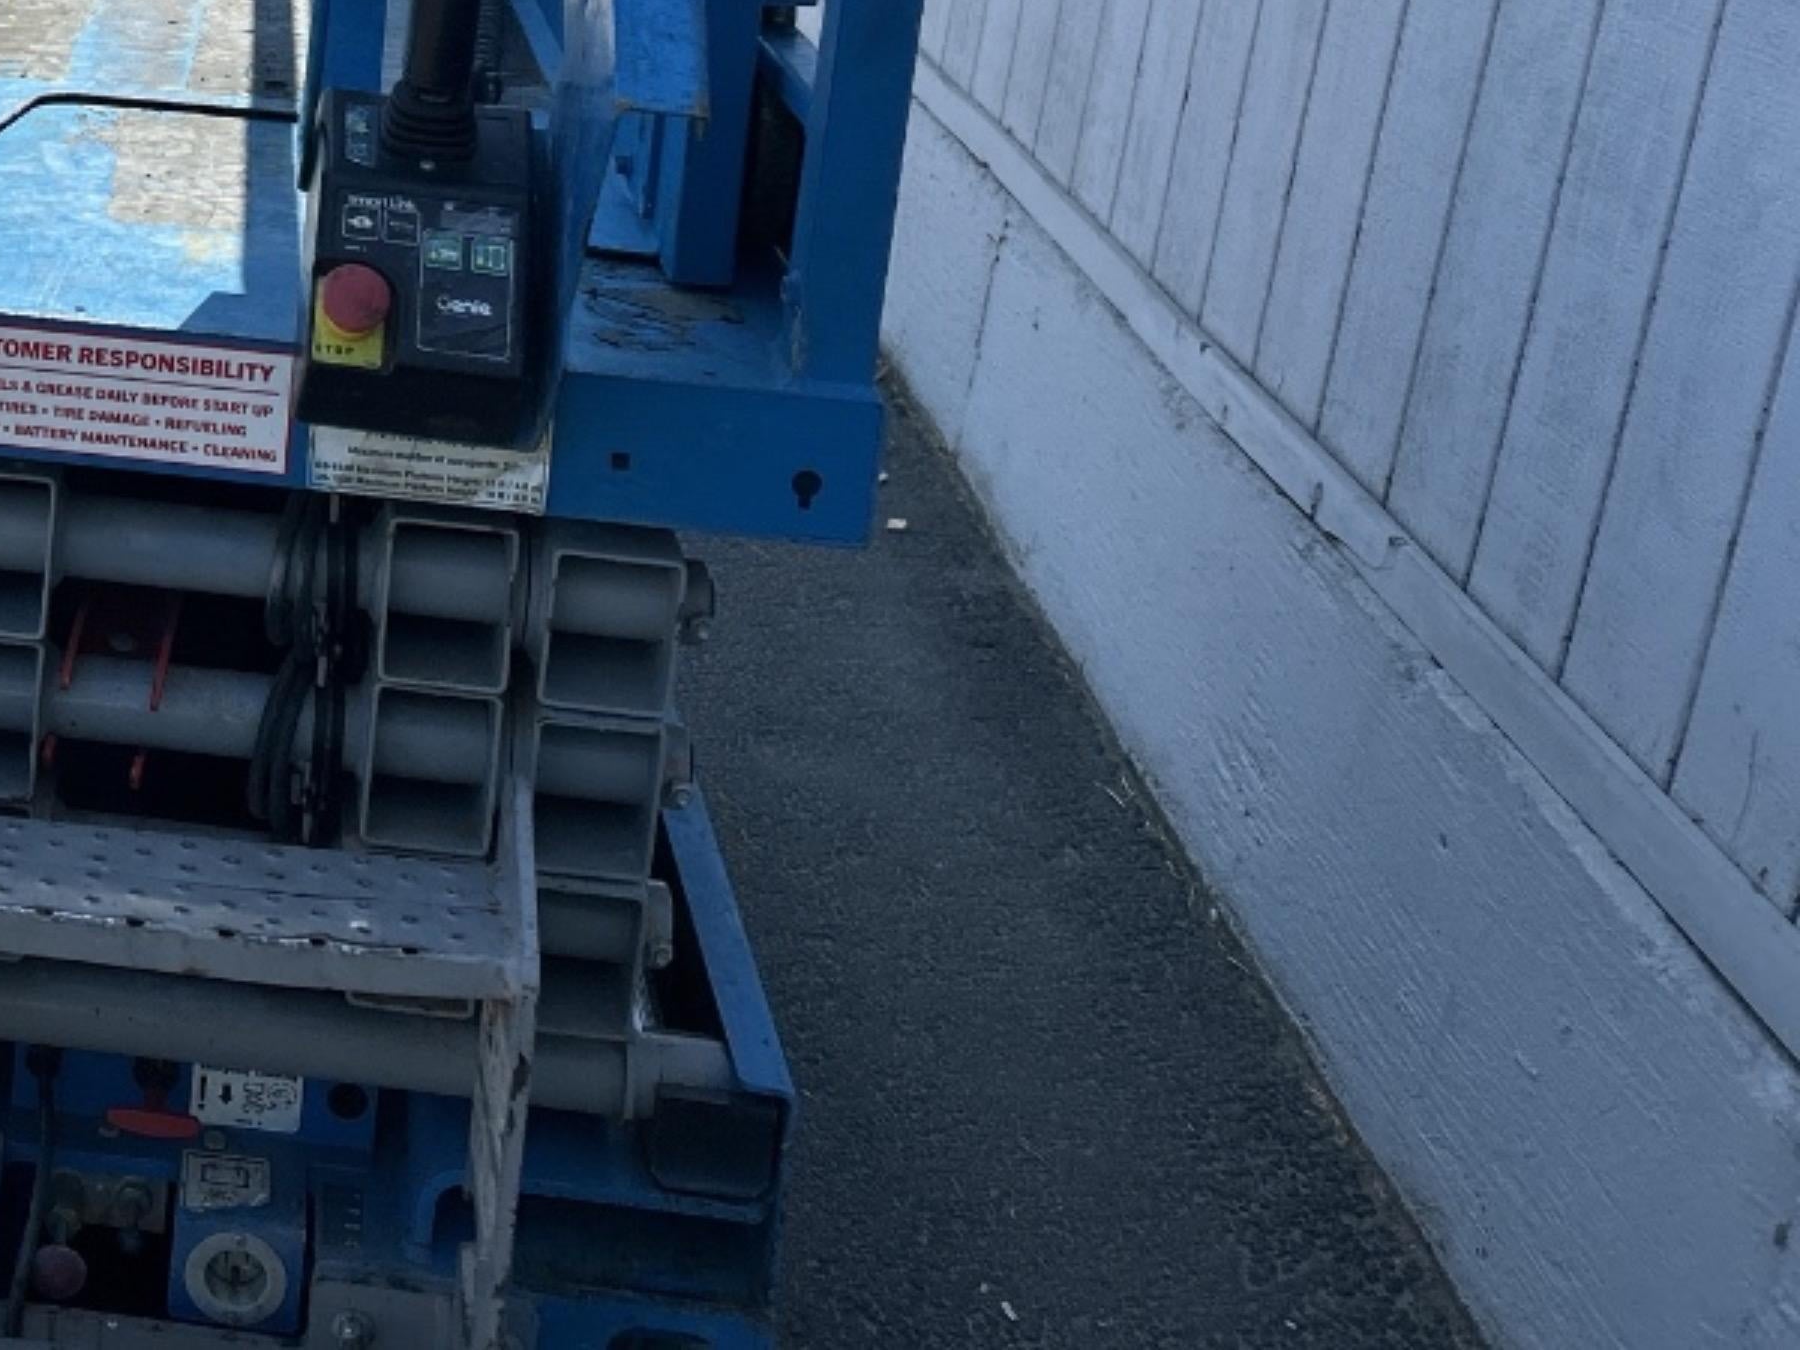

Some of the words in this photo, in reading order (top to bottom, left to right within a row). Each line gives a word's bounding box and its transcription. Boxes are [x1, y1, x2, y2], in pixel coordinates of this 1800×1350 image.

[78, 346, 276, 383] RESPONSIBILITY
[36, 381, 93, 400] GREASE
[96, 388, 138, 404] DAILY
[143, 392, 198, 410] BEFORE
[203, 398, 248, 416] START
[88, 409, 150, 428] DAMAGE
[165, 416, 247, 438] REFUELING
[14, 423, 78, 442] BATTERY
[81, 430, 189, 454] MAINTENANCE
[203, 443, 277, 463] CLEANING
